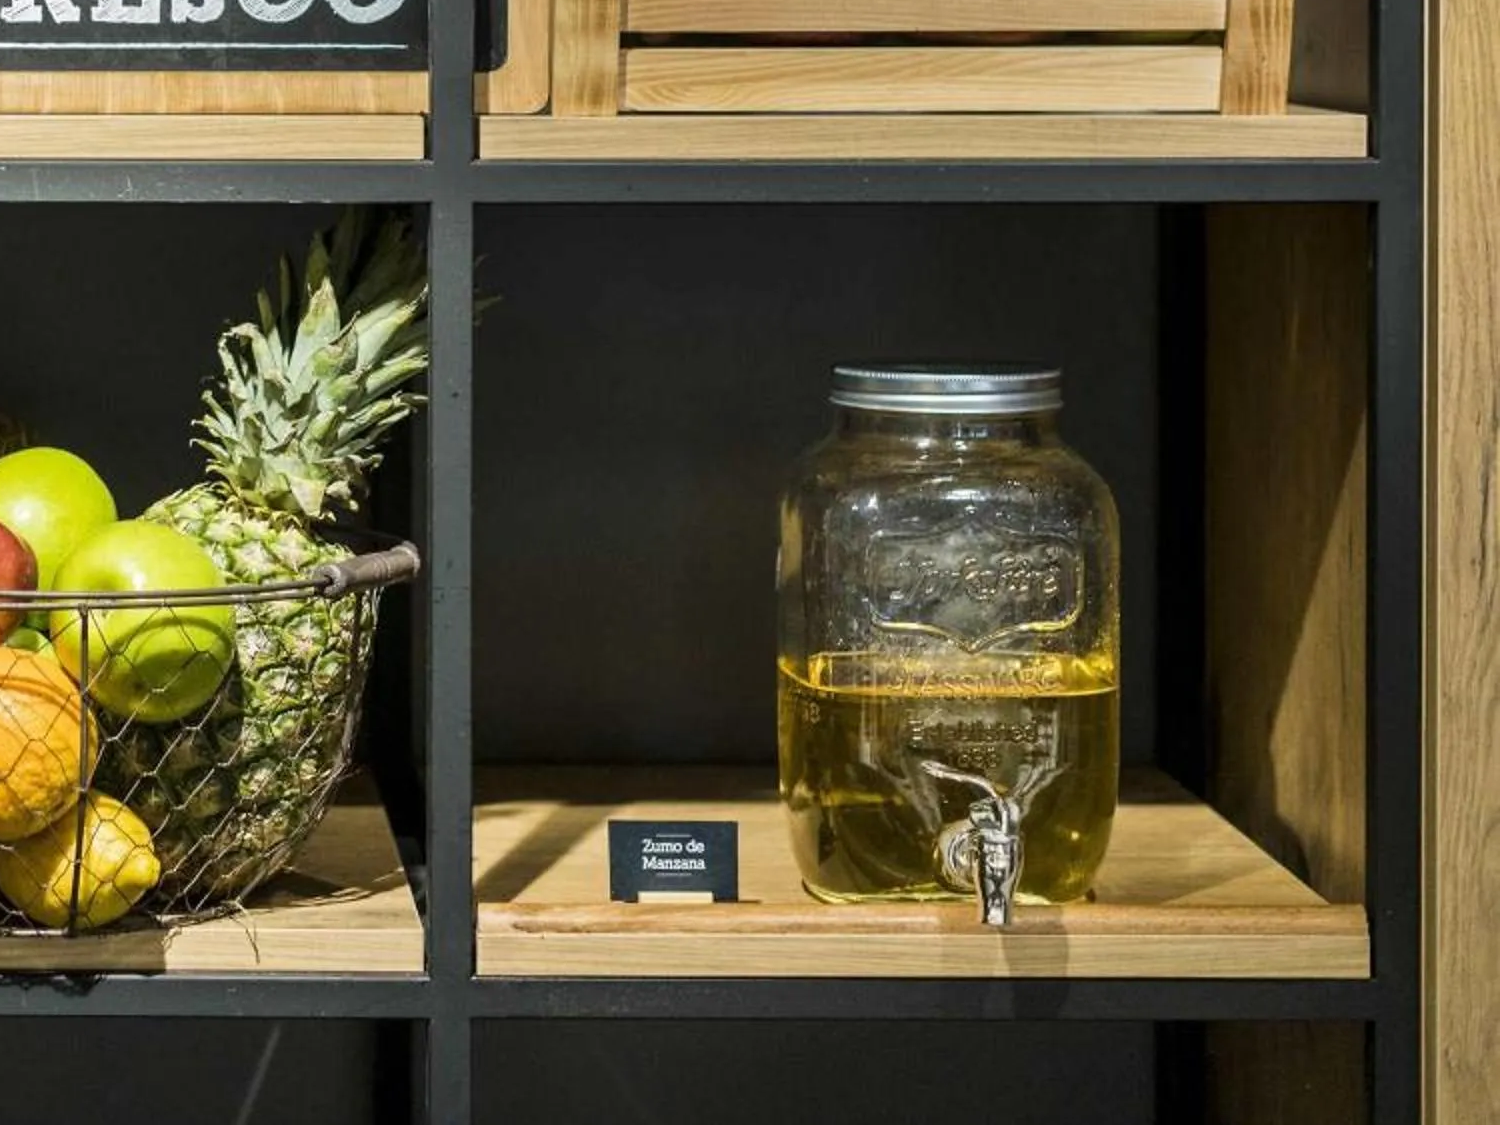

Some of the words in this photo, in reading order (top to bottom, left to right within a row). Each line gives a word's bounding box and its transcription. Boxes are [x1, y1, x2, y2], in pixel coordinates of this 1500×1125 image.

[641, 838, 682, 853] Zumo
[685, 839, 705, 853] de
[642, 856, 706, 870] Manzana
